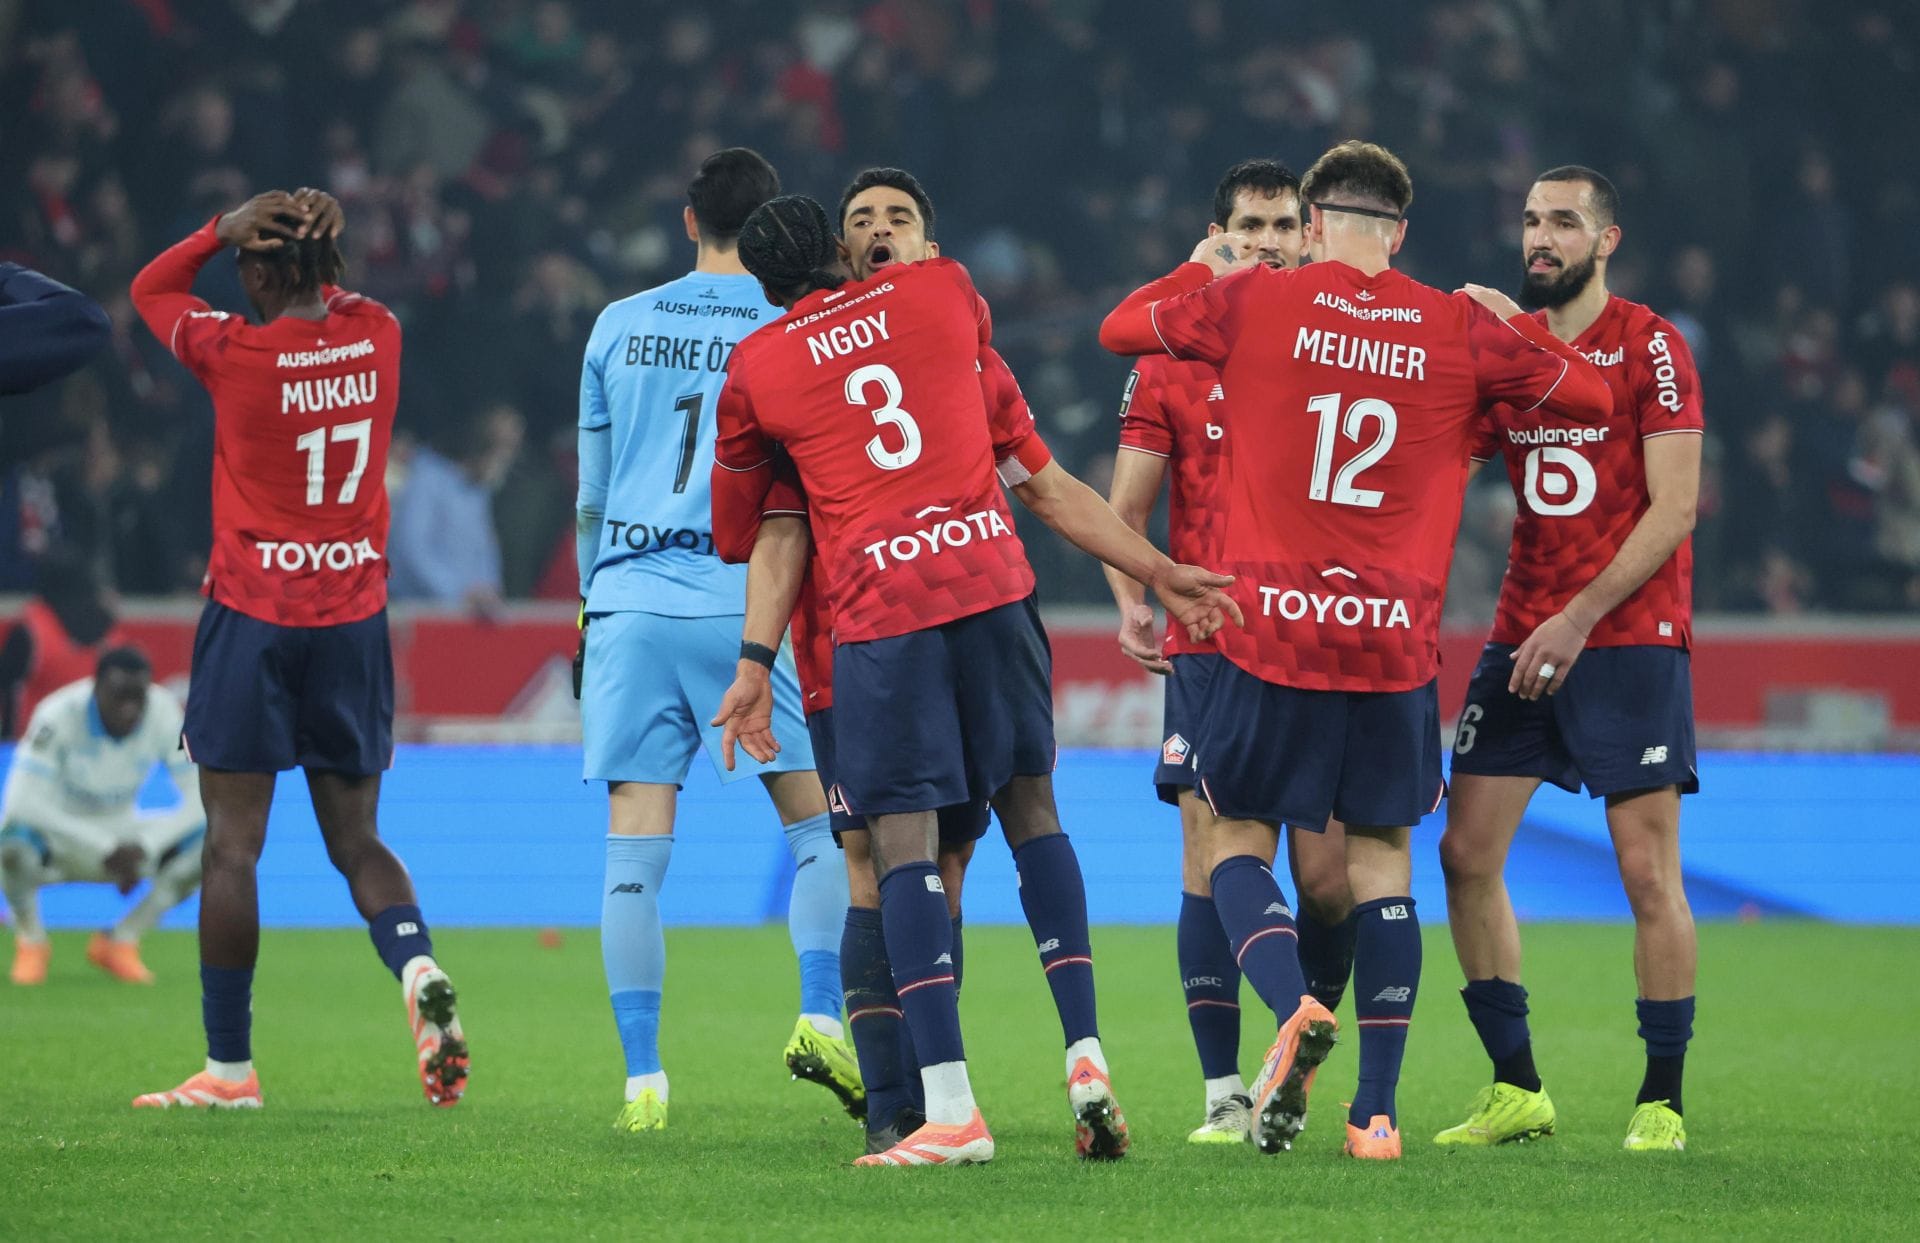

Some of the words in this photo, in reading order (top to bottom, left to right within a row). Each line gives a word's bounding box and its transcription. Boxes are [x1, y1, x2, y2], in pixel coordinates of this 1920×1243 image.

[653, 300, 759, 320] AUSHOPPING
[785, 281, 895, 334] AUSHOPPING
[1313, 291, 1422, 324] AUSHOPPING
[276, 338, 376, 368] AUSHOPPING
[625, 334, 703, 371] BERKE
[806, 310, 890, 366] NGOY
[1293, 326, 1427, 382] MEUNIER
[281, 370, 377, 415] MUKAU
[844, 363, 923, 471] 3
[1507, 425, 1610, 447] boulanger
[296, 417, 373, 506] 17
[673, 392, 705, 495] 1
[1306, 392, 1398, 508] 12
[255, 536, 382, 572] TOYOTA
[864, 508, 1013, 572] TOYOTA
[1258, 586, 1412, 630] TOYOTA
[1455, 703, 1484, 755] 6
[1384, 905, 1405, 917] 12
[1183, 976, 1222, 990] LOSC
